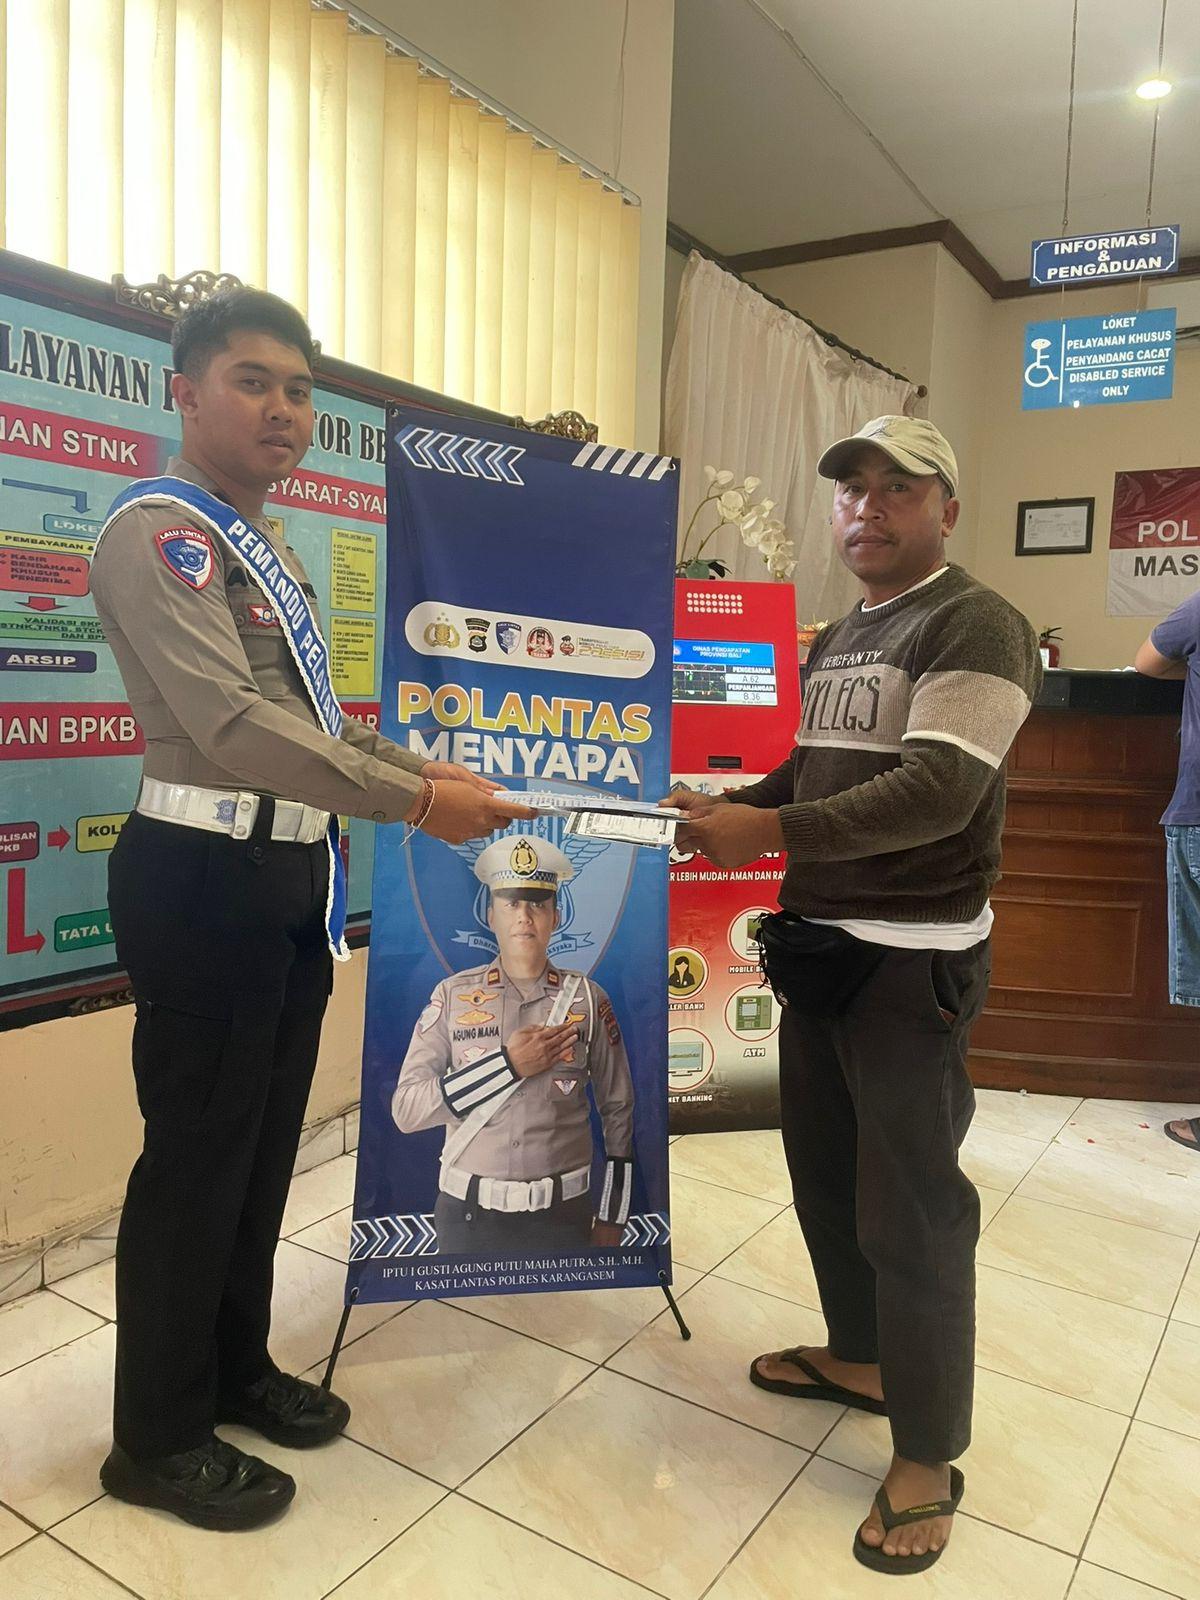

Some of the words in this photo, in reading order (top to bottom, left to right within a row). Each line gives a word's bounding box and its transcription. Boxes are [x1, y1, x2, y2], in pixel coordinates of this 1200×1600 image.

[1054, 232, 1157, 255] INFORMASI
[1098, 250, 1110, 262] &
[1047, 256, 1162, 280] PENGADUAN
[1103, 317, 1137, 330] LOKET
[1067, 336, 1126, 350] PELAYANAN
[1128, 331, 1172, 344] KHUSUS
[1066, 351, 1134, 367] PENYANDANG
[1137, 347, 1172, 361] CACAT
[1070, 369, 1119, 383] DISABLED
[1122, 365, 1166, 379] SERVICE
[1102, 385, 1130, 398] ONLY
[62, 429, 139, 466] STNK
[53, 520, 102, 534] LOKE
[1138, 519, 1199, 543] POL
[5, 535, 84, 550] PEMBAYARAN
[160, 530, 179, 540] LALU
[181, 529, 207, 542] LINTAS
[11, 553, 48, 564] KASIR
[1134, 553, 1199, 577] MAS
[11, 560, 82, 573] BENDAHARA
[11, 574, 71, 585] PENERIMA
[227, 519, 308, 631] PEMANDU
[24, 617, 76, 627] VALIDASI
[6, 654, 77, 665] ARSIP
[398, 681, 652, 743] POLANTAS
[0, 716, 48, 745] AN
[59, 716, 137, 744] BPKB
[409, 729, 641, 784] MENYAPA
[88, 824, 124, 837] KOL
[677, 871, 698, 881] LEBIH
[700, 871, 729, 881] MUDAH
[730, 871, 754, 881] AMAN
[755, 870, 772, 880] DAN
[59, 925, 101, 942] TATA
[729, 965, 755, 973] MOBILE
[684, 1002, 705, 1011] BANK
[453, 1028, 476, 1041] AGUNG
[477, 1026, 500, 1038] MAHA
[743, 1048, 766, 1058] ATM
[681, 1094, 713, 1103] BANKING
[383, 1267, 408, 1278] IPTU
[417, 1264, 450, 1276] GUSTI
[452, 1262, 492, 1274] AGUNG
[494, 1260, 522, 1271] PUTU
[525, 1259, 557, 1270] MAHA
[559, 1257, 597, 1268] PUTRA,
[415, 1279, 451, 1291] KASAT
[453, 1277, 496, 1289] LANTAS
[498, 1273, 539, 1286] POLRES
[541, 1270, 615, 1283] KARANGASEM
